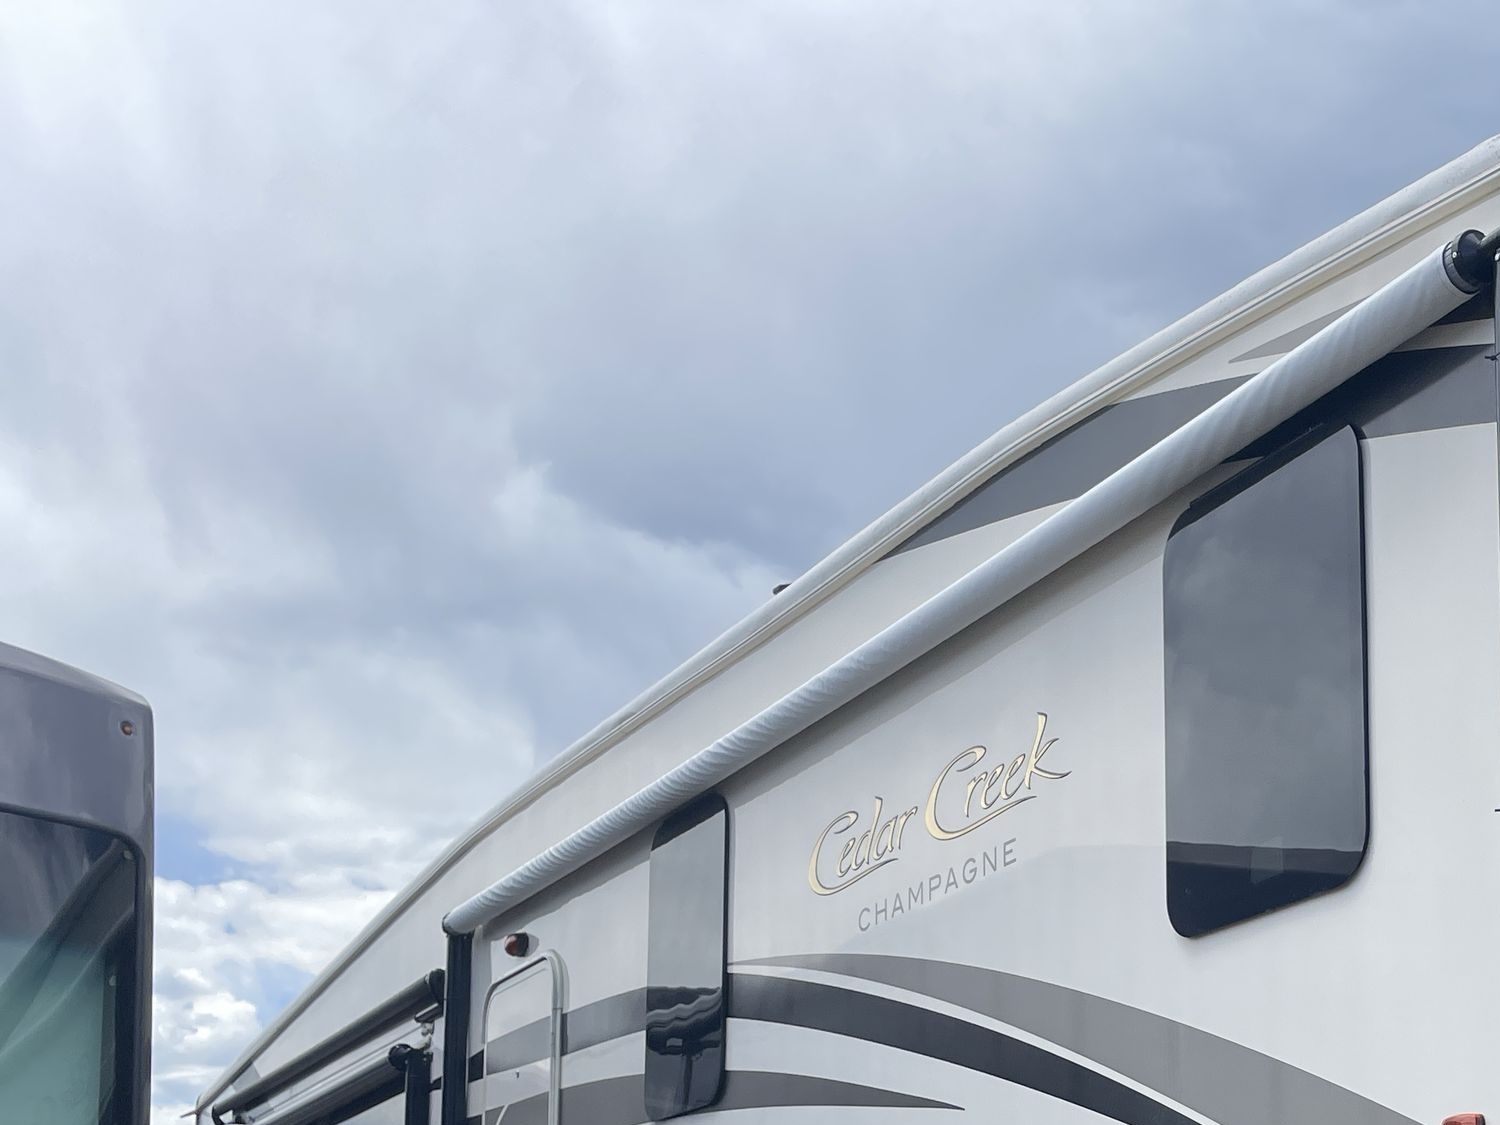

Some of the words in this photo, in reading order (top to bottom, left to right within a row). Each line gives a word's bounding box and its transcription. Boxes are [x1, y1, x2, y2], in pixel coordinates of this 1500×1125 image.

[807, 796, 919, 897] Cedar
[924, 711, 1073, 841] Creek
[857, 837, 1017, 932] CHAMPAGNE
